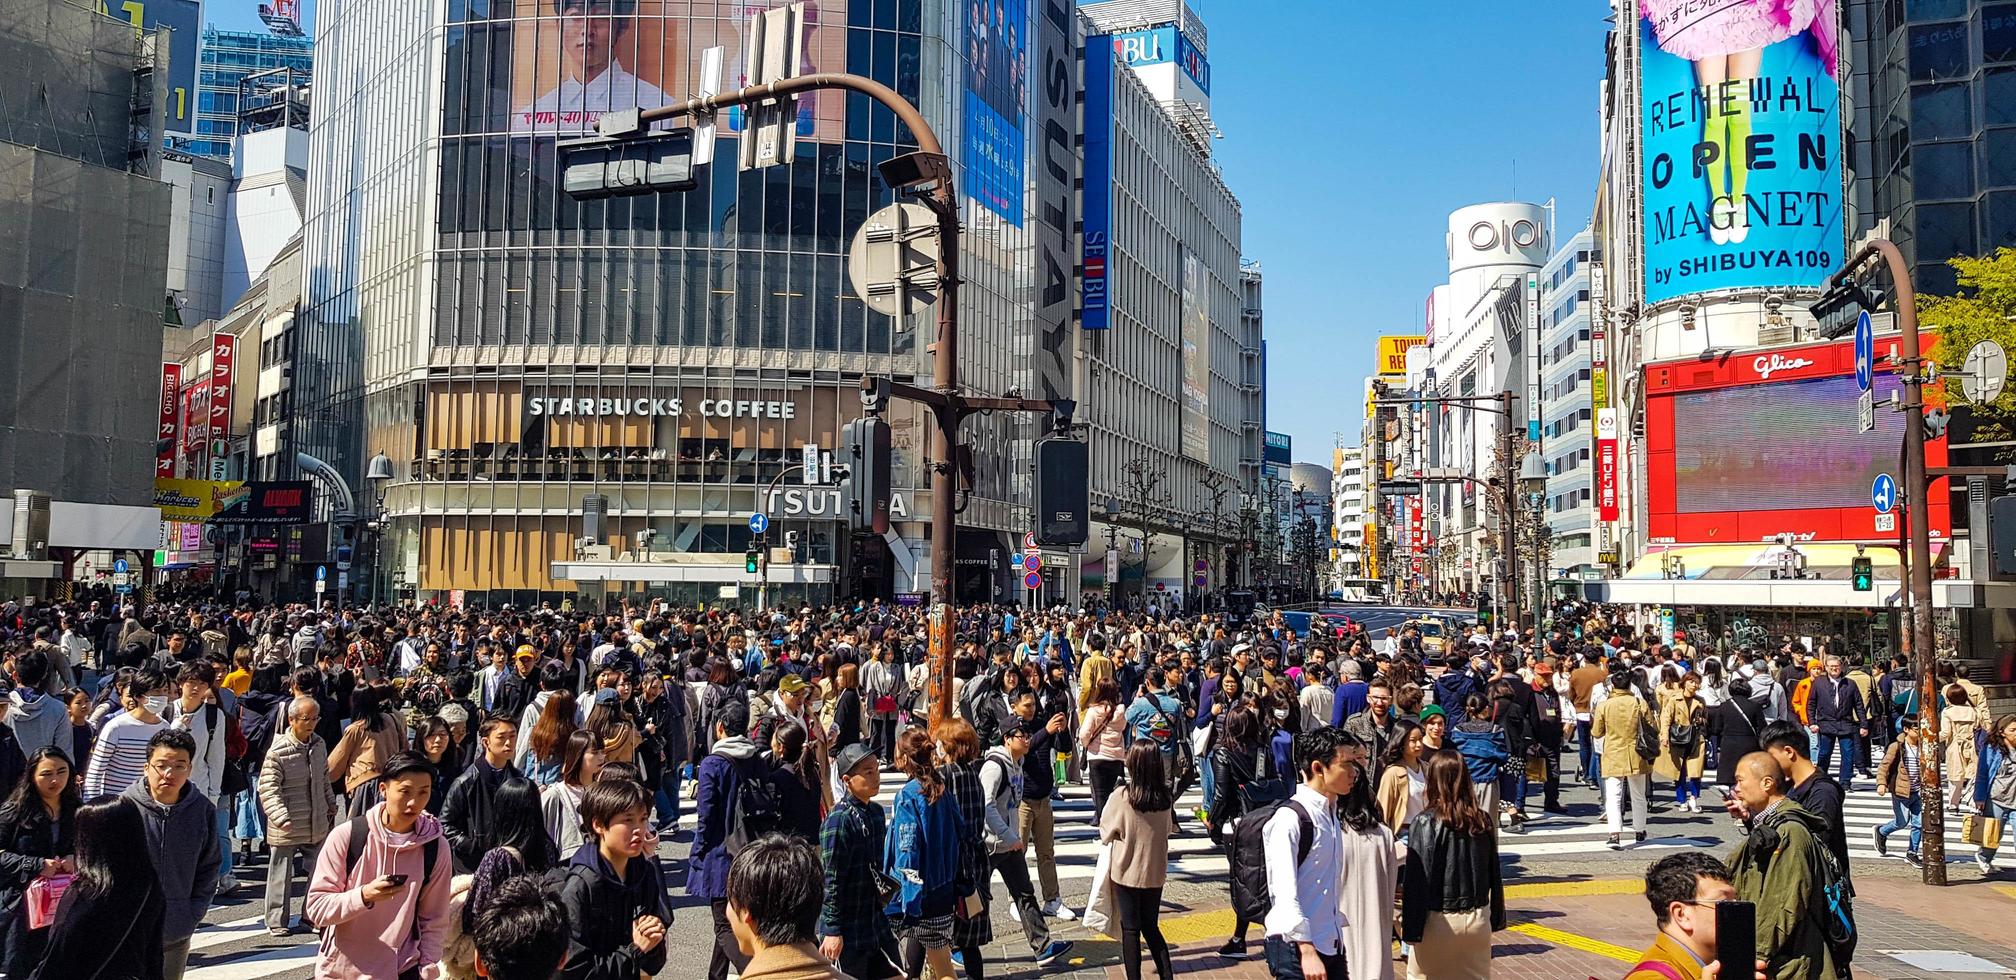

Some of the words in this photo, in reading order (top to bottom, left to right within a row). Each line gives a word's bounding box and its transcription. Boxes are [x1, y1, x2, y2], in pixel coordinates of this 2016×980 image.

[1114, 34, 1159, 62] BU
[1652, 77, 1825, 136] RENEWAL
[1652, 133, 1826, 190] OPEN
[1654, 191, 1828, 245] MAGNET
[1084, 231, 1105, 310] SEIBU
[1655, 266, 1672, 284] by
[1679, 249, 1831, 277] SHIBUYA109
[1500, 300, 1521, 341] ZAR
[211, 344, 231, 418] カラオケ
[1753, 353, 1813, 379] Glico
[190, 385, 210, 413] カラオ
[529, 397, 683, 416] STARBUCKS
[700, 399, 795, 418] COFFEE
[1266, 433, 1289, 447] NITORI
[213, 461, 225, 481] Me
[1602, 445, 1614, 508] 三菱UFJ銀行
[762, 489, 907, 517] TSUTA
